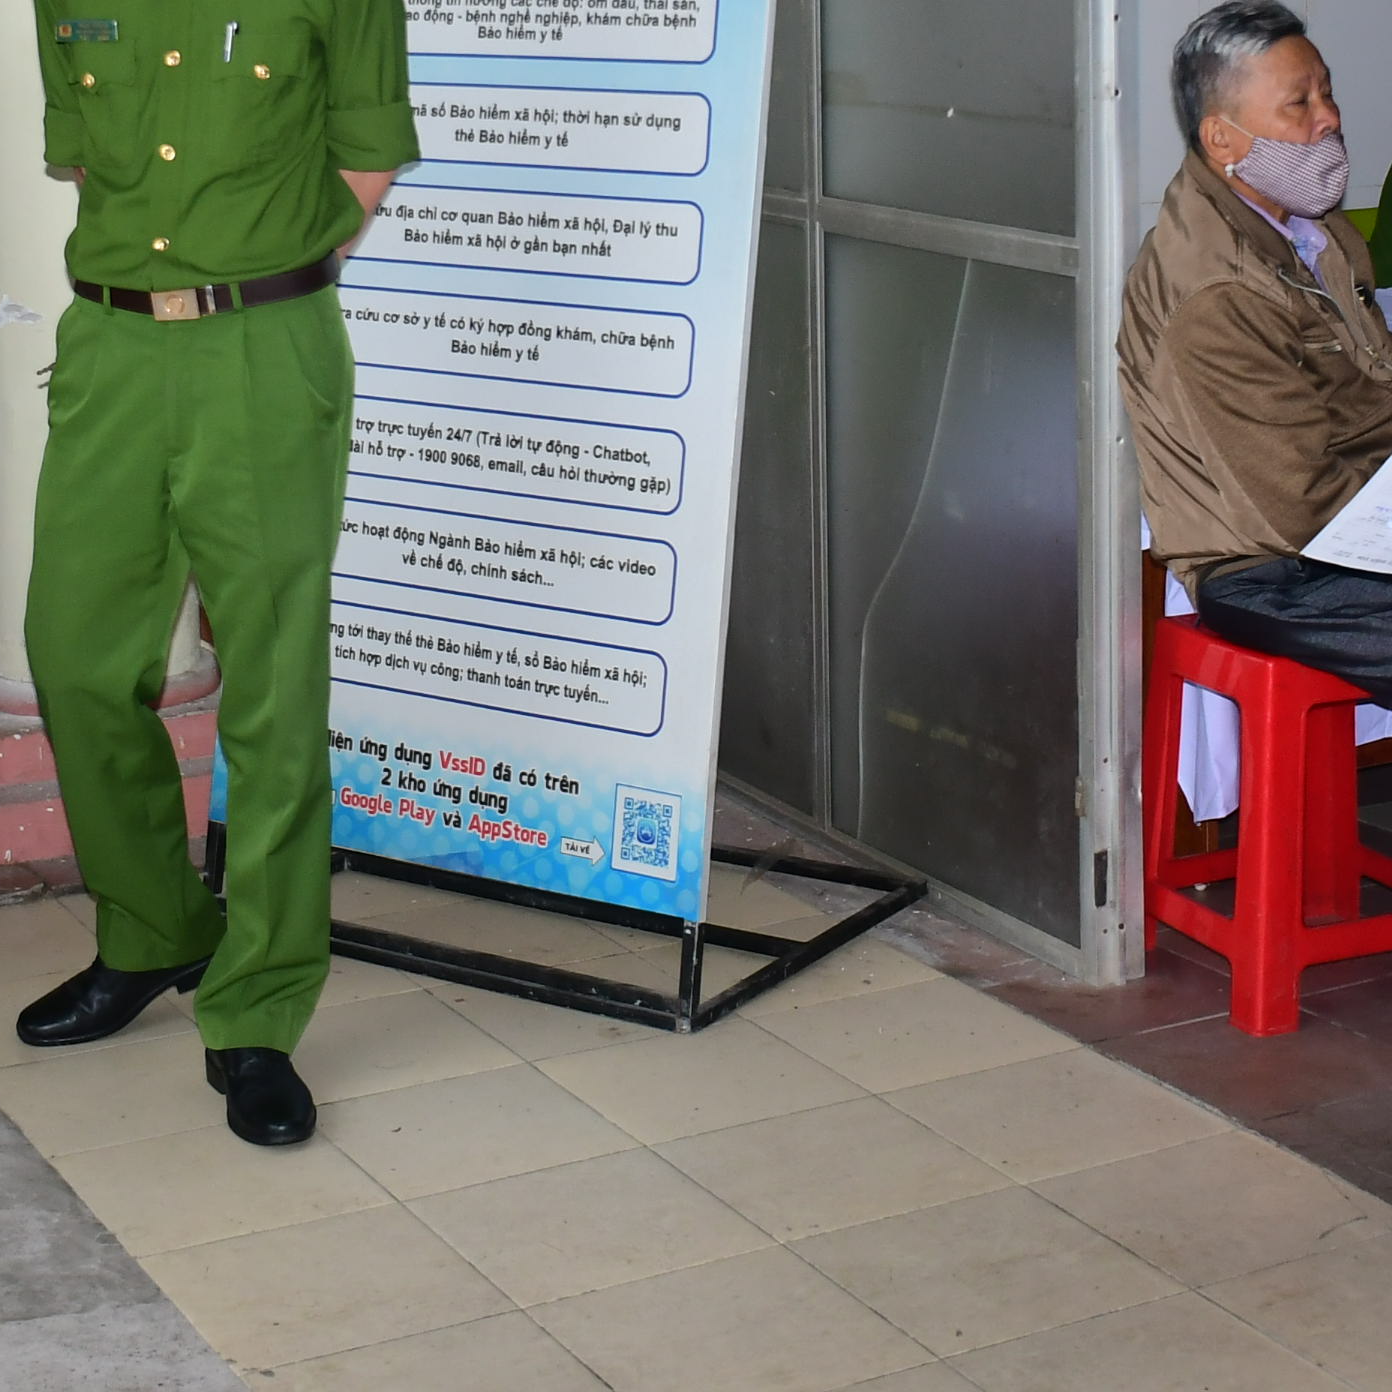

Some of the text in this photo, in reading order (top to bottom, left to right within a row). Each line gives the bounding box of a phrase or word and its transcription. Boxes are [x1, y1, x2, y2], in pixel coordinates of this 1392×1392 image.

[454, 128, 568, 150] thẻ Bảo hiểm y tế
[335, 645, 608, 704] tích hợp dịch vụ công; thanh toán trực tuyến...
[359, 736, 388, 762] ứng
[394, 742, 432, 771] dụng
[439, 750, 485, 776] VssID
[492, 761, 512, 782] đã
[518, 768, 537, 787] có
[544, 772, 579, 795] trên
[380, 767, 508, 814] 2 kho ứng dụng
[341, 787, 548, 846] Google Play và AppStore
